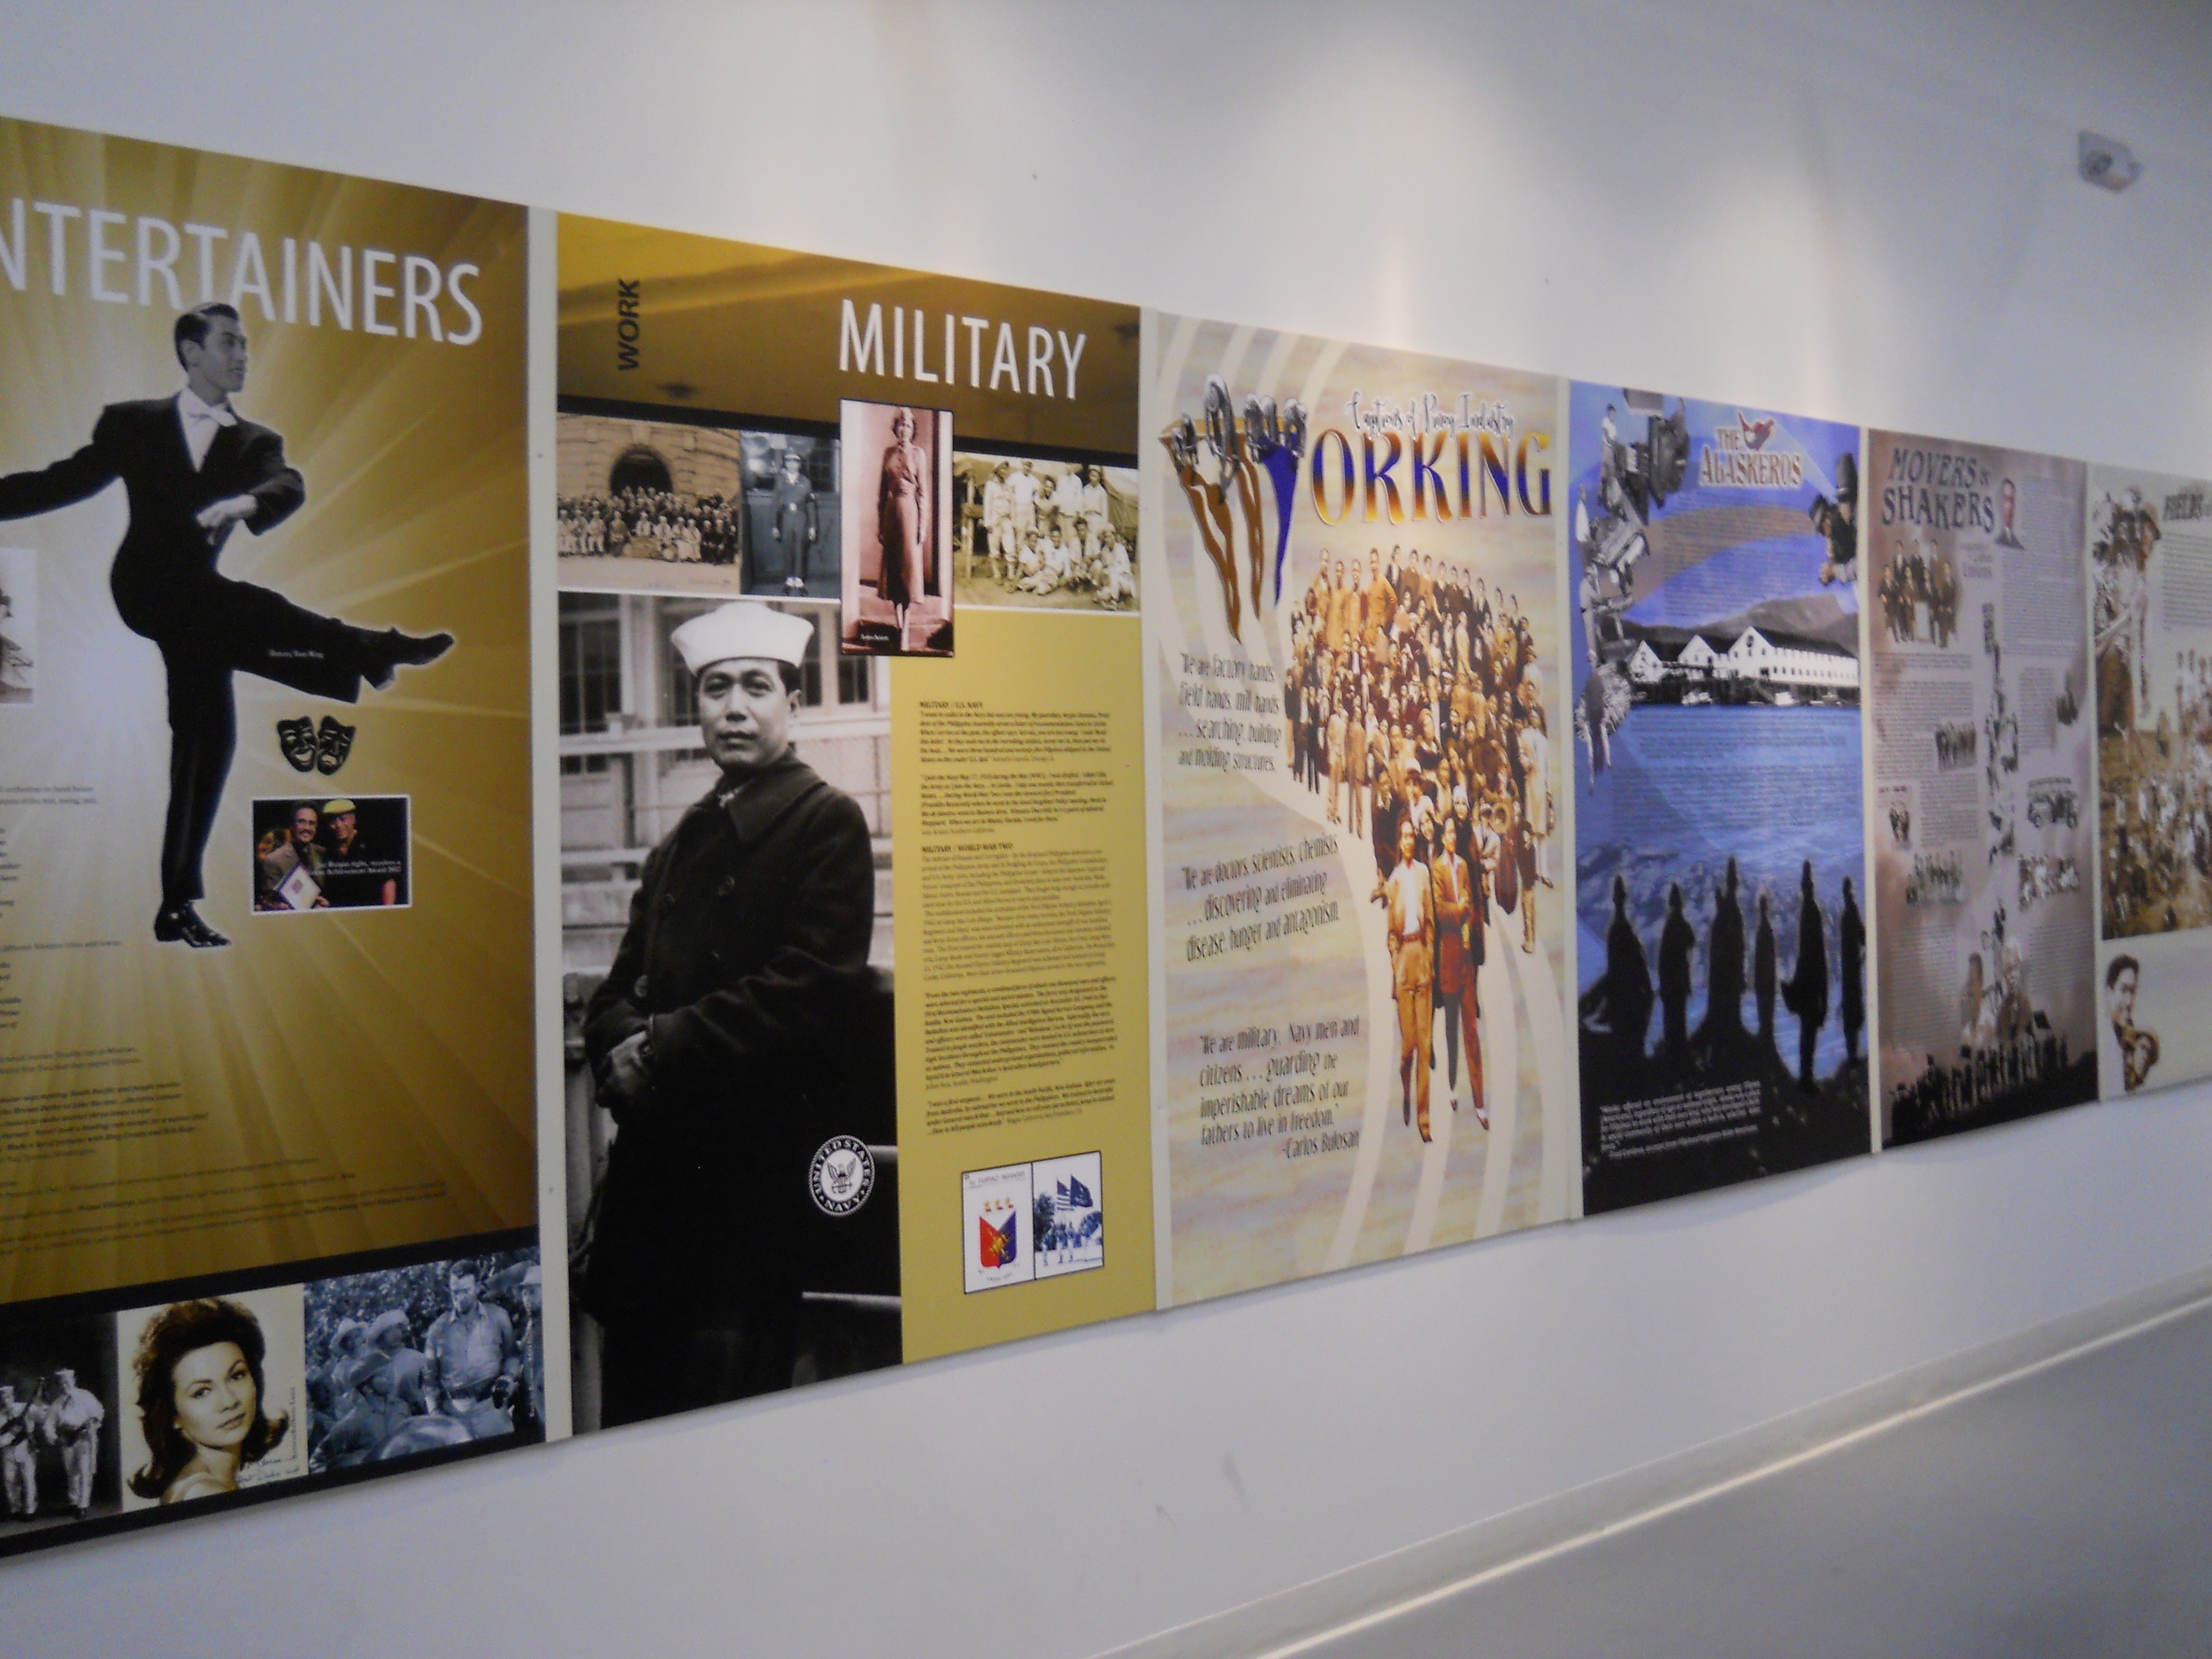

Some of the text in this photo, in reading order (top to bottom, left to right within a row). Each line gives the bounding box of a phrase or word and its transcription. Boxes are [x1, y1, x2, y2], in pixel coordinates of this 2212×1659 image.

[618, 278, 641, 371] WORK
[839, 297, 1087, 401] MILITARY
[1457, 393, 1515, 442] Industry
[1717, 428, 1740, 450] THE
[1701, 445, 1802, 486] ALASKEROS
[1887, 447, 1978, 488] MOVERS
[1882, 485, 1994, 534] SHAKERS
[1218, 1034, 1235, 1053] are
[1289, 1022, 1311, 1046] Navy
[1315, 1020, 1338, 1041] men
[1340, 1014, 1360, 1038] and
[1272, 1082, 1316, 1109] dreams
[1317, 1079, 1330, 1102] of
[1333, 1080, 1350, 1100] our
[1200, 1122, 1240, 1147] fathers
[1242, 1120, 1255, 1140] to
[1256, 1116, 1276, 1137] live
[1278, 1113, 1288, 1134] in
[1321, 1130, 1361, 1154] Bulosan
[812, 1139, 871, 1194] UNITED STATES
[824, 1193, 860, 1212] NAVY
